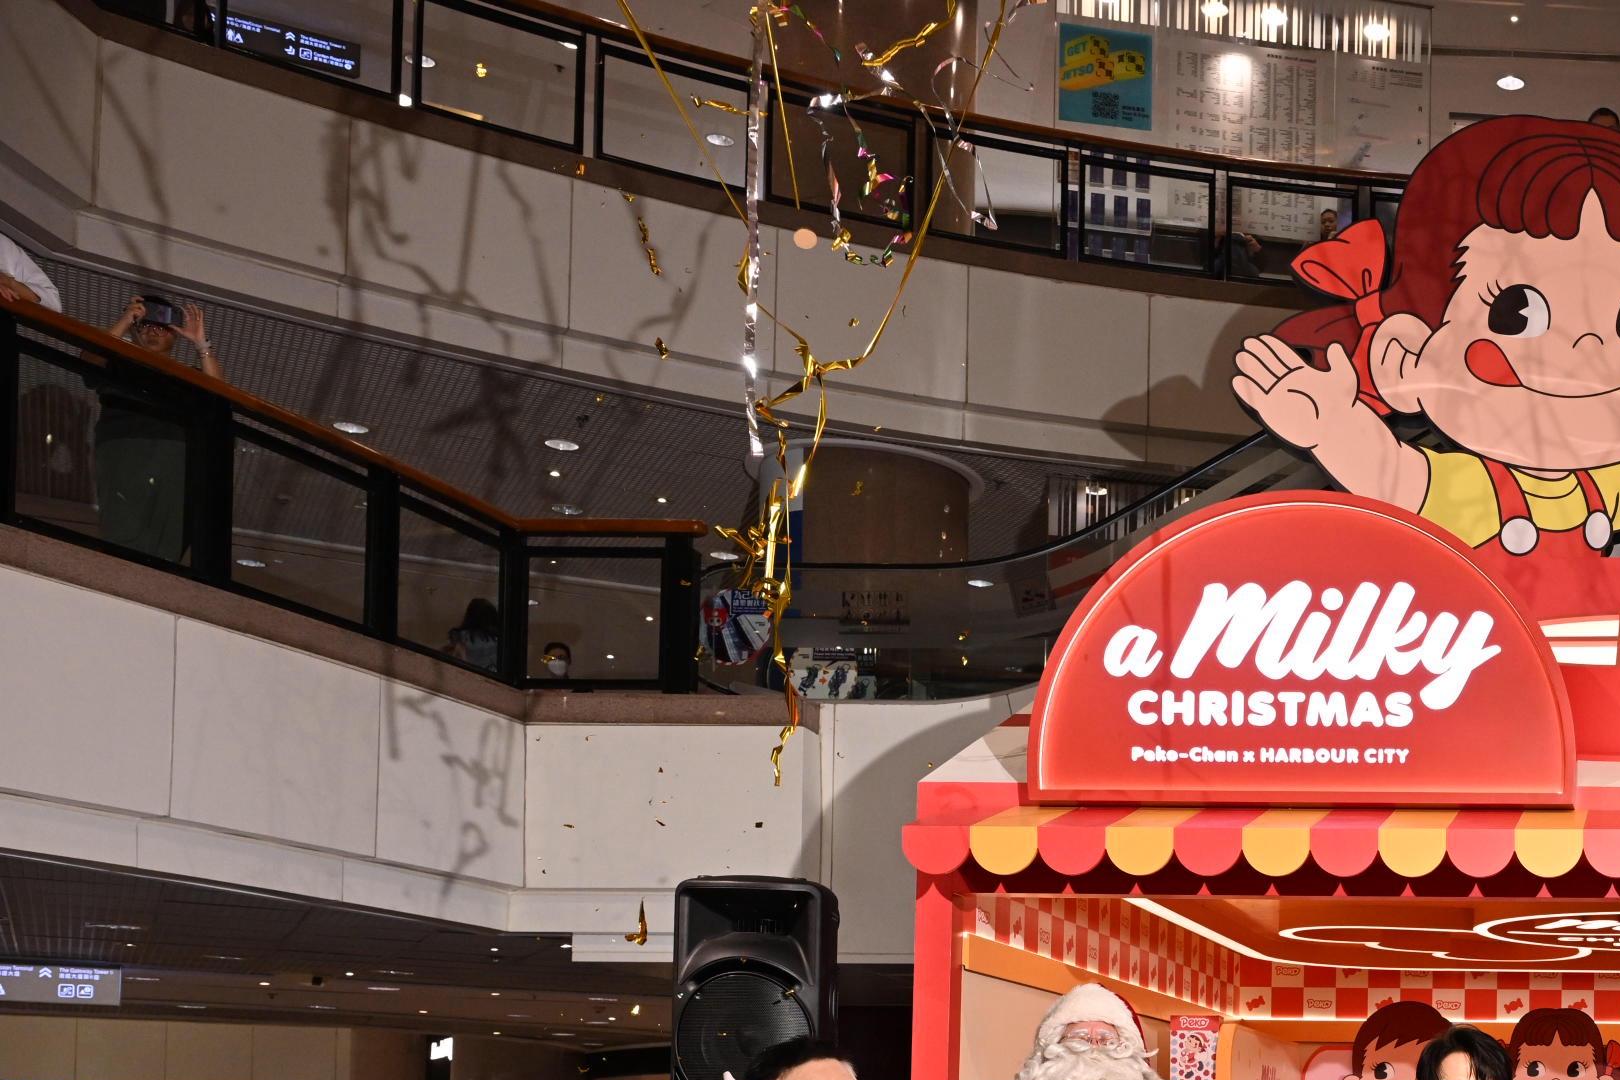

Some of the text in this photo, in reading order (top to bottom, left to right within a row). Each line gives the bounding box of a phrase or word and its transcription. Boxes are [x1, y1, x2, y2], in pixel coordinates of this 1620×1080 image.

[1104, 580, 1501, 710] a Milky
[1128, 690, 1414, 727] CHRISTMAS
[1131, 745, 1239, 763] Peko-Chan
[1259, 747, 1359, 764] HARBOUR
[1365, 747, 1410, 765] CITY
